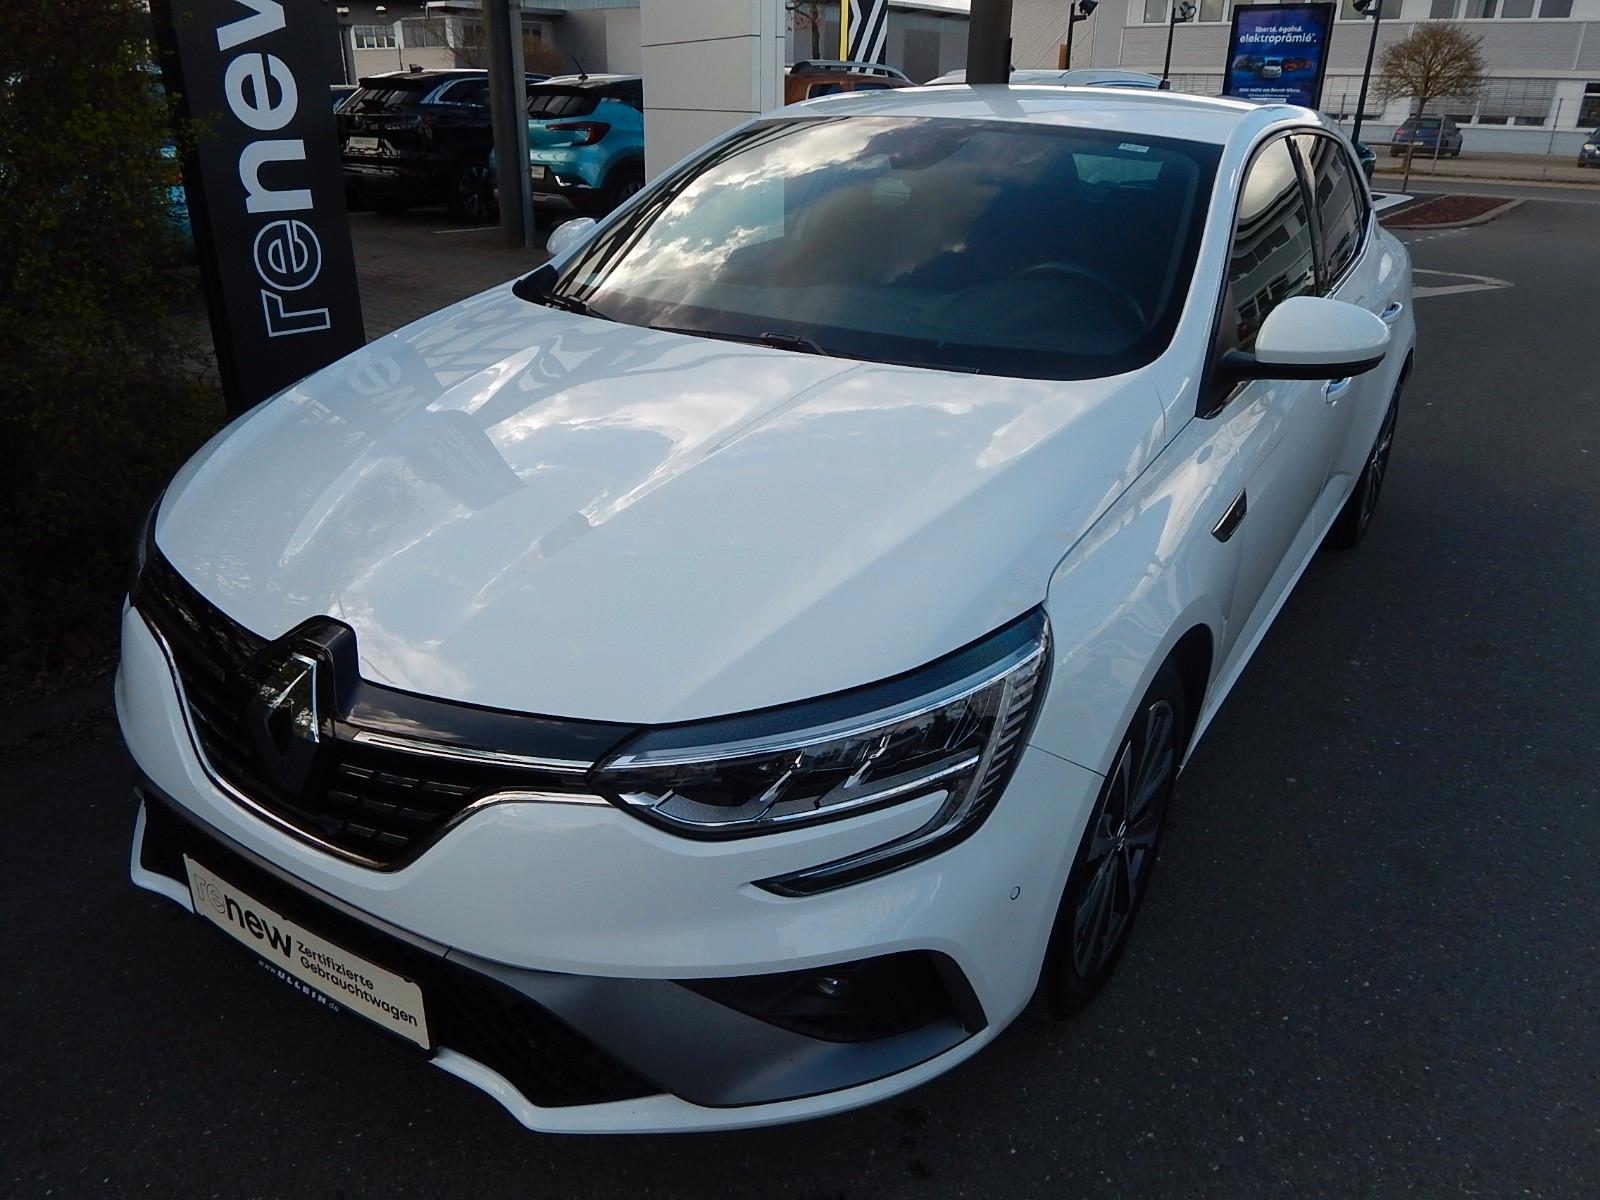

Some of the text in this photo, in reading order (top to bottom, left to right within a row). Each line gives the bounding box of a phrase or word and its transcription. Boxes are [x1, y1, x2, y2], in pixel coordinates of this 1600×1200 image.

[193, 873, 292, 958] renew
[297, 940, 375, 990] Zertifizierte
[300, 957, 418, 1027] Gebrauchtwagen
